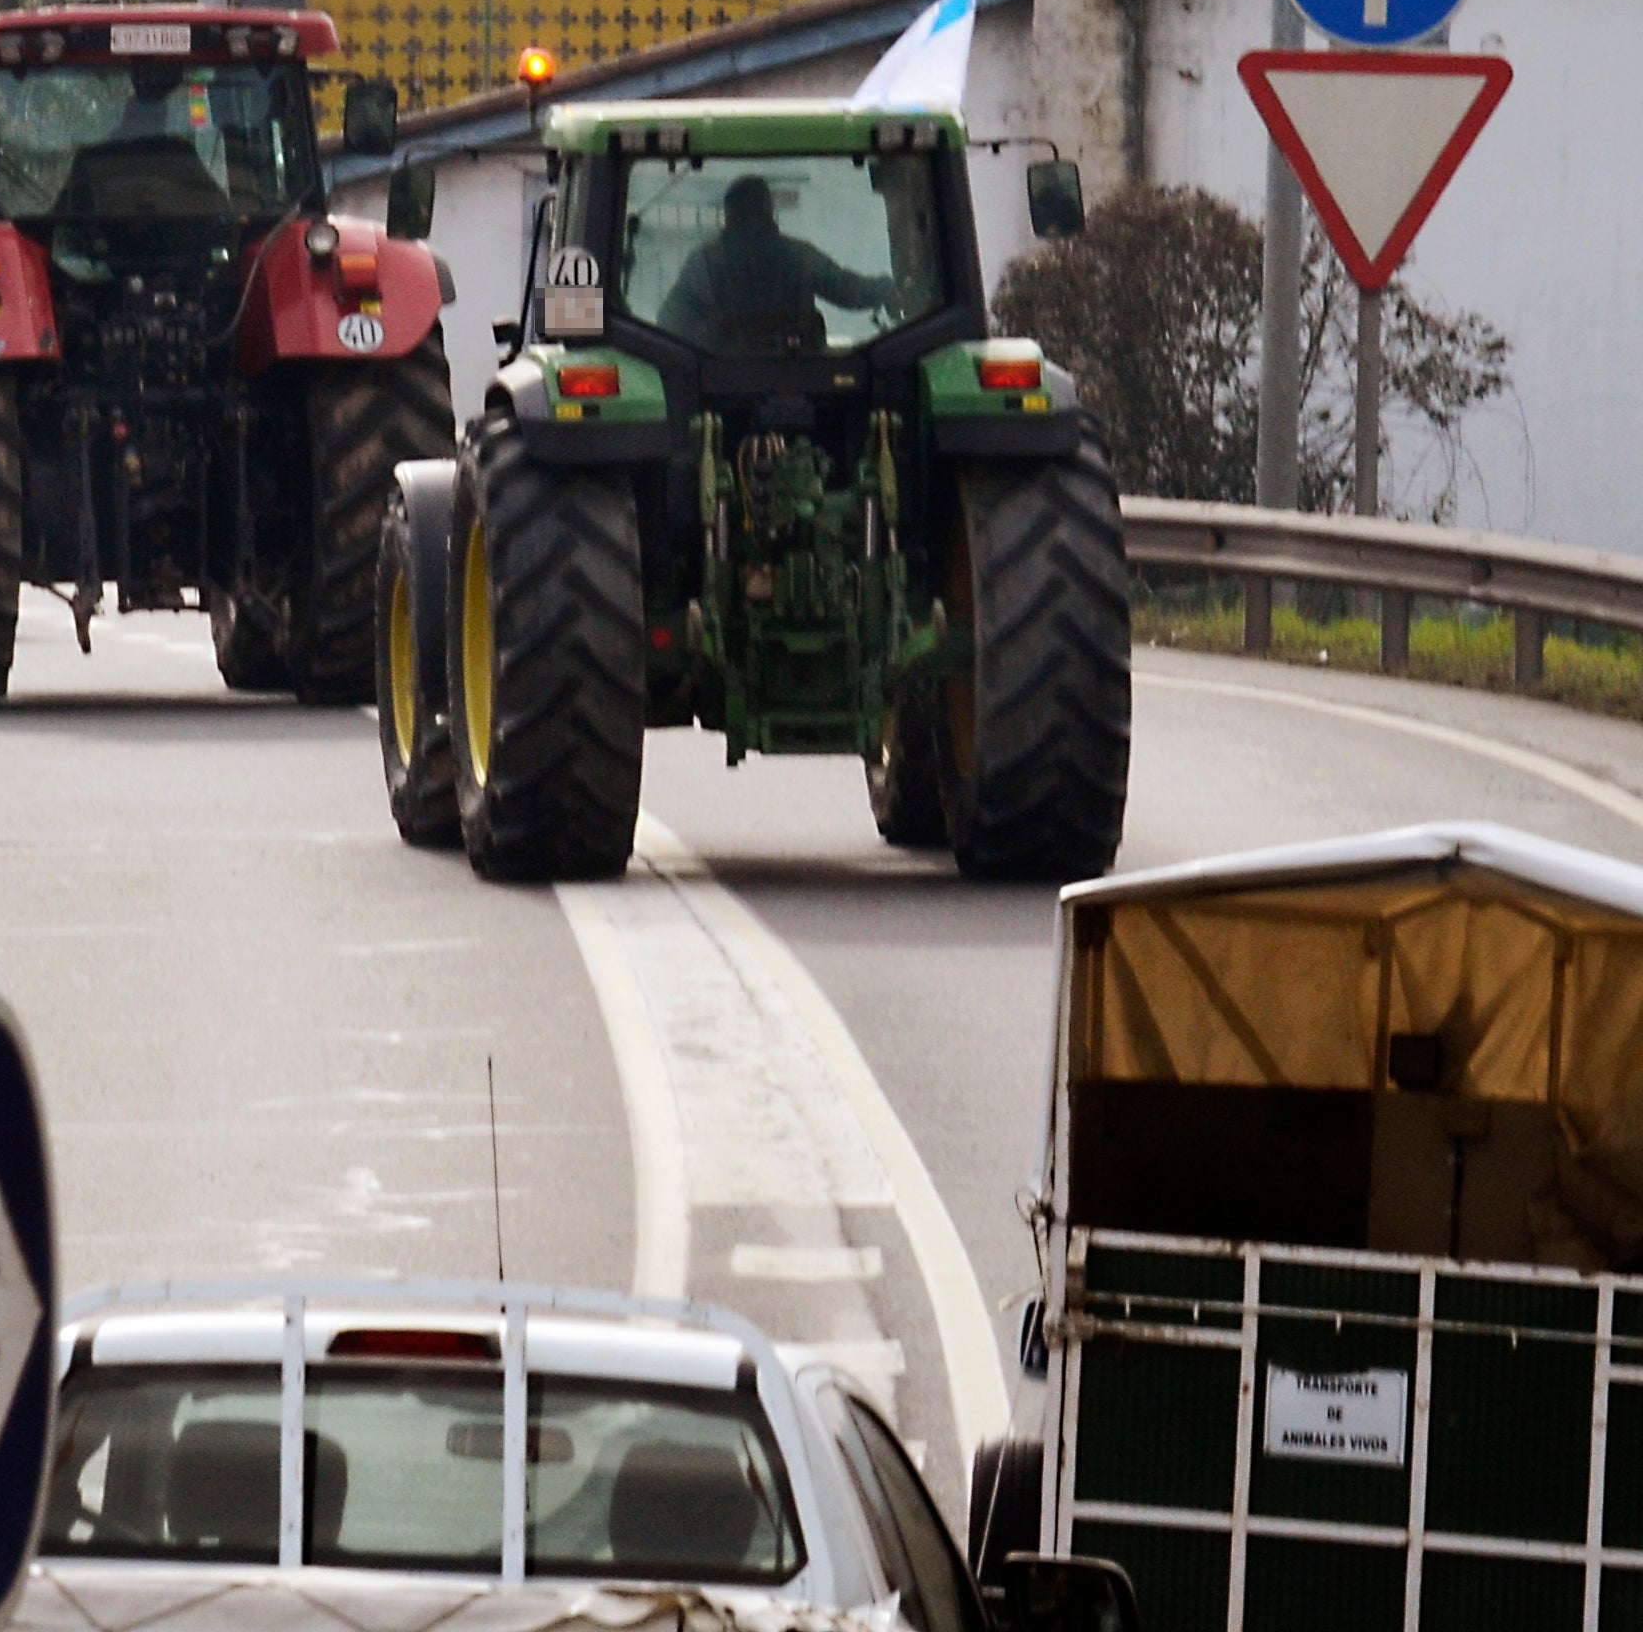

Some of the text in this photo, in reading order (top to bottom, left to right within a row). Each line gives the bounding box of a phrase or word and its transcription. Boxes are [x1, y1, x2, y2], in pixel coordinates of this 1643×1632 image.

[343, 316, 377, 347] 40
[1327, 1405, 1343, 1422] DE
[1281, 1429, 1388, 1453] ANIMALES VIVOS
